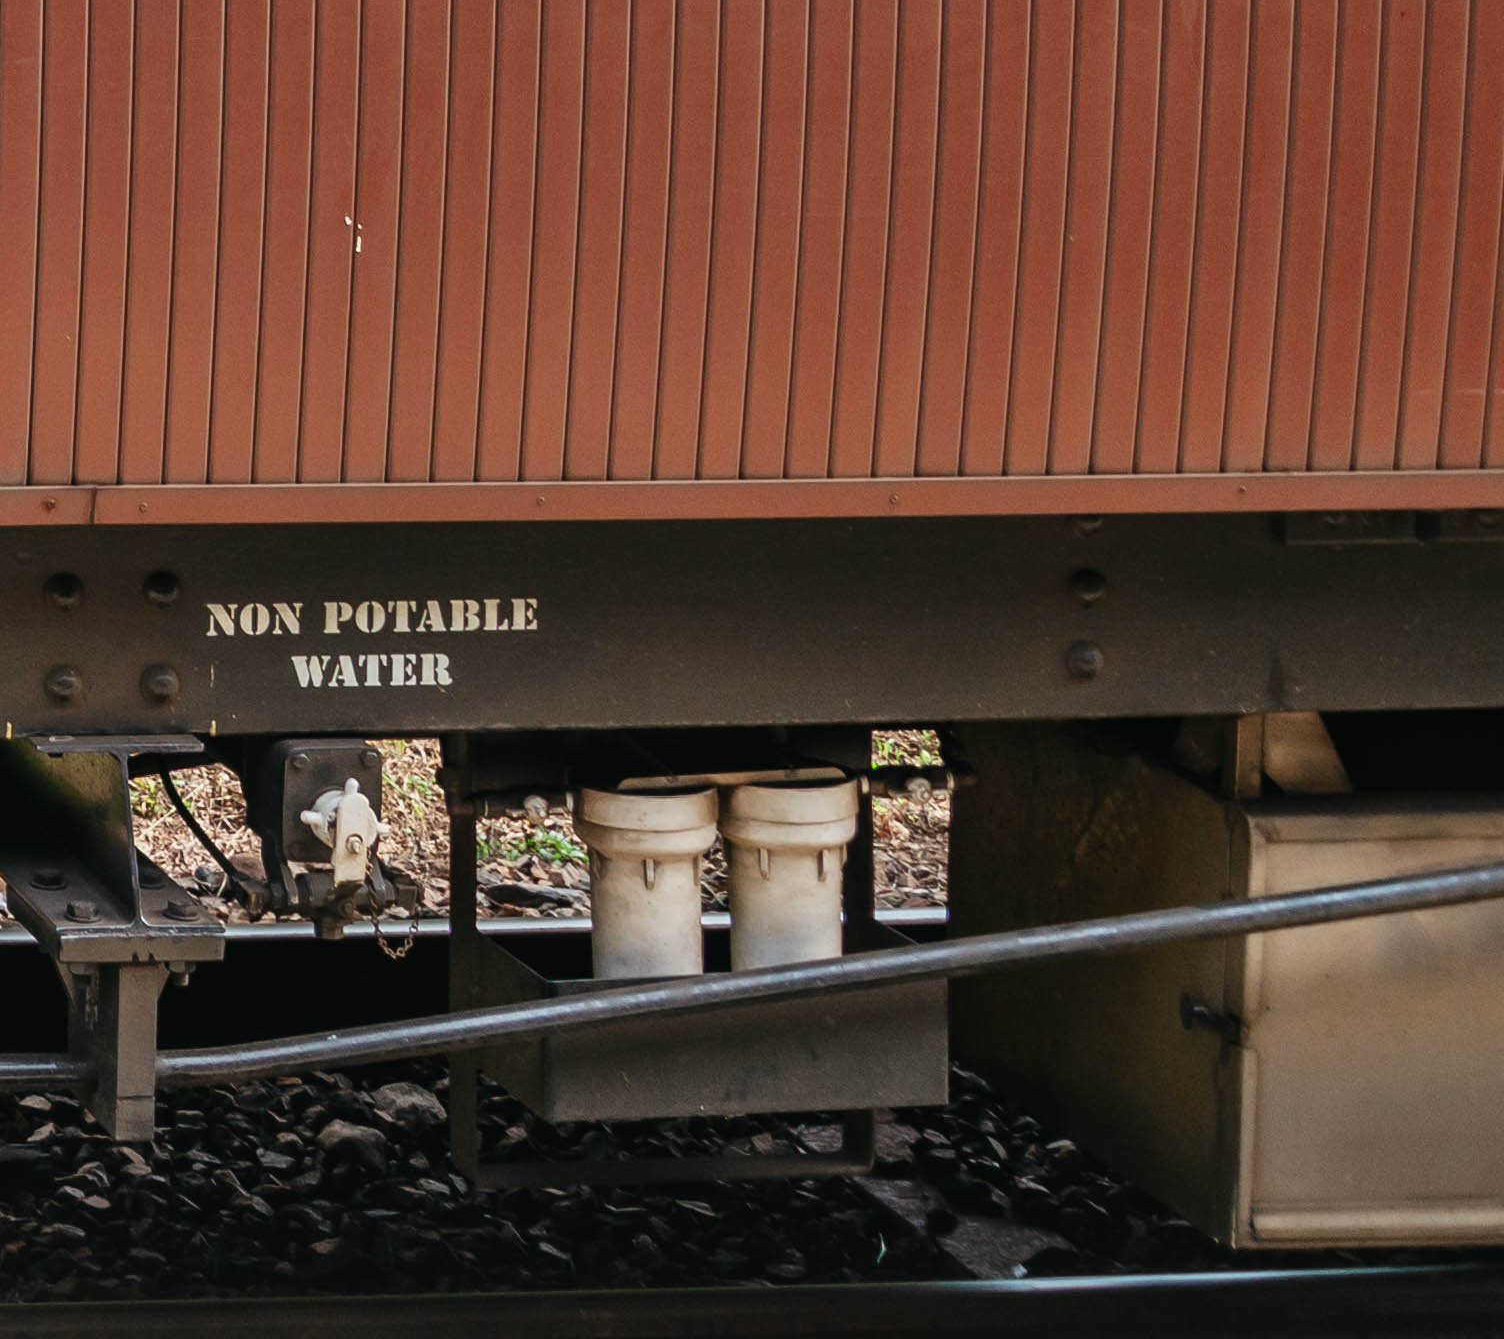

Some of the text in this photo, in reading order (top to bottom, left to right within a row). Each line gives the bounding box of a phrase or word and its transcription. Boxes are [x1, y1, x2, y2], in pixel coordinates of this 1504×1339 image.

[205, 598, 539, 637] NON POTABLE
[291, 653, 453, 688] WATER
